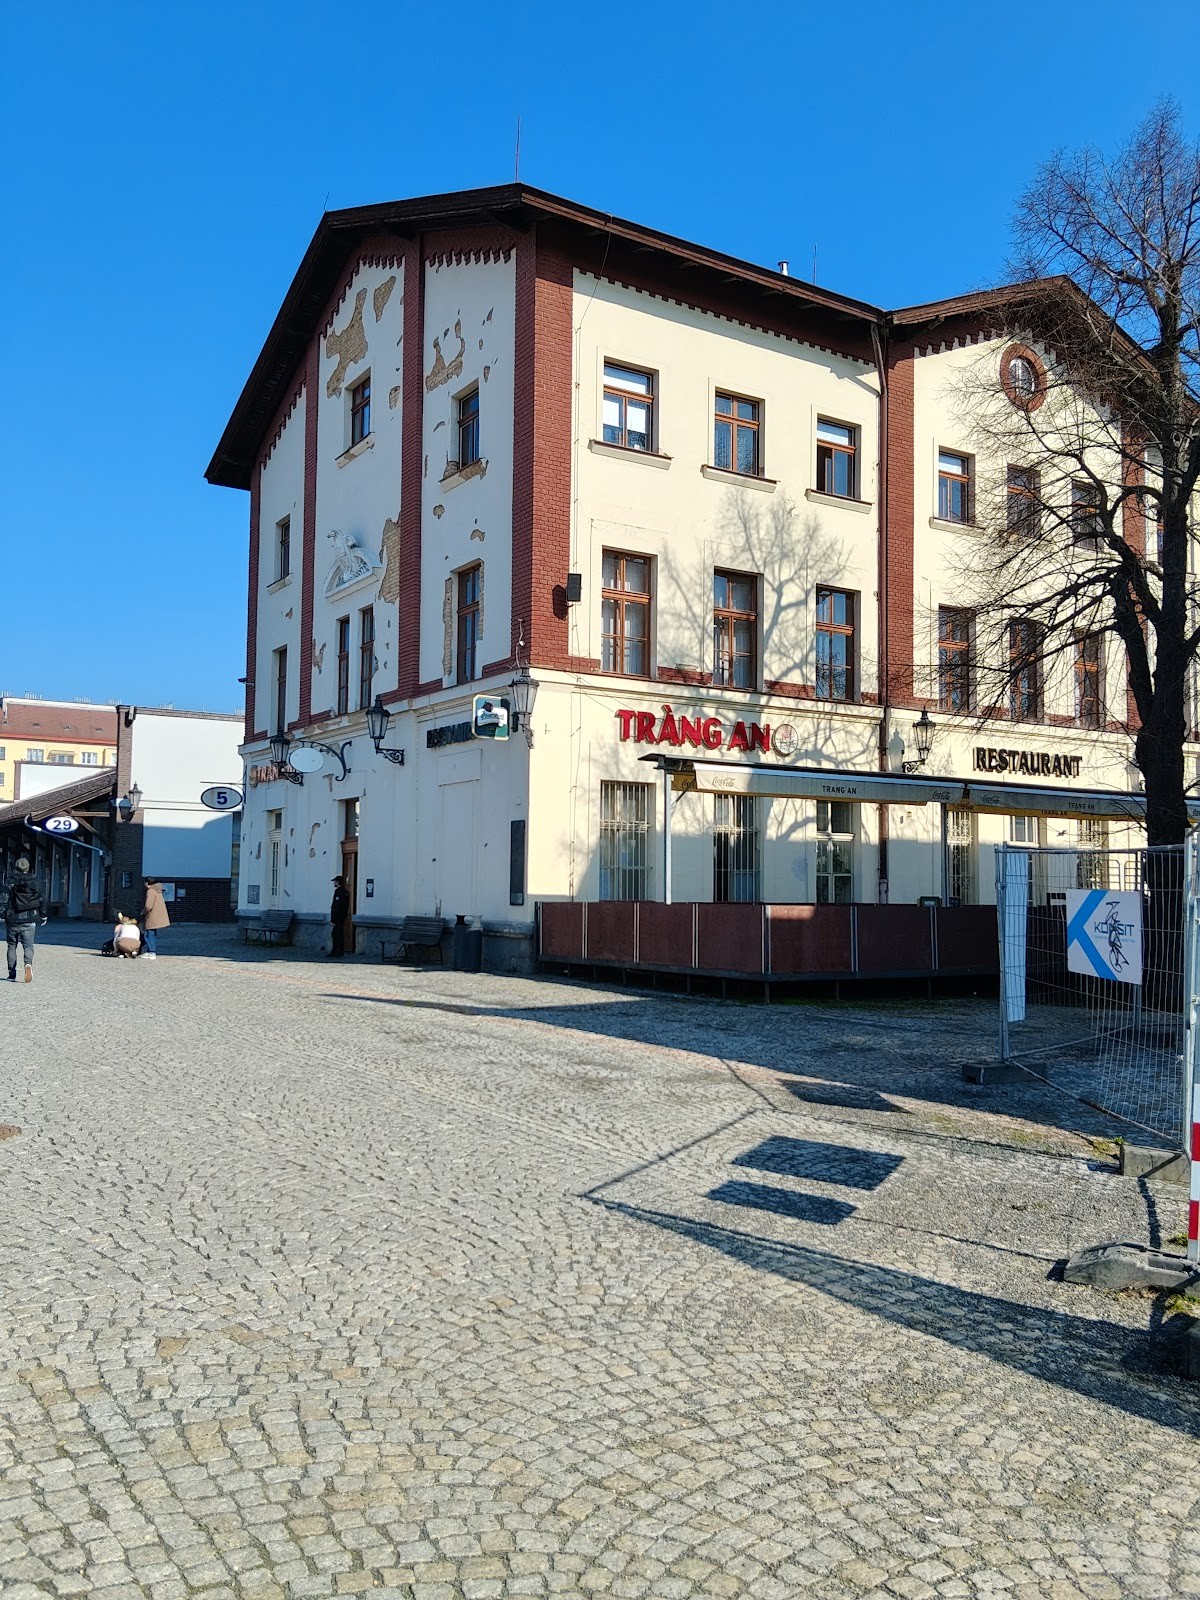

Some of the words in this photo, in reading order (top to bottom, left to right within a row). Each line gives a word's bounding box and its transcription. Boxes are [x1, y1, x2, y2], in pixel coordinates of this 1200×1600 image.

[727, 721, 771, 753] AN
[973, 747, 1083, 778] RESTAURANT
[822, 785, 845, 794] TRANG
[847, 787, 857, 795] AN
[216, 791, 228, 805] 5
[53, 819, 72, 831] 29
